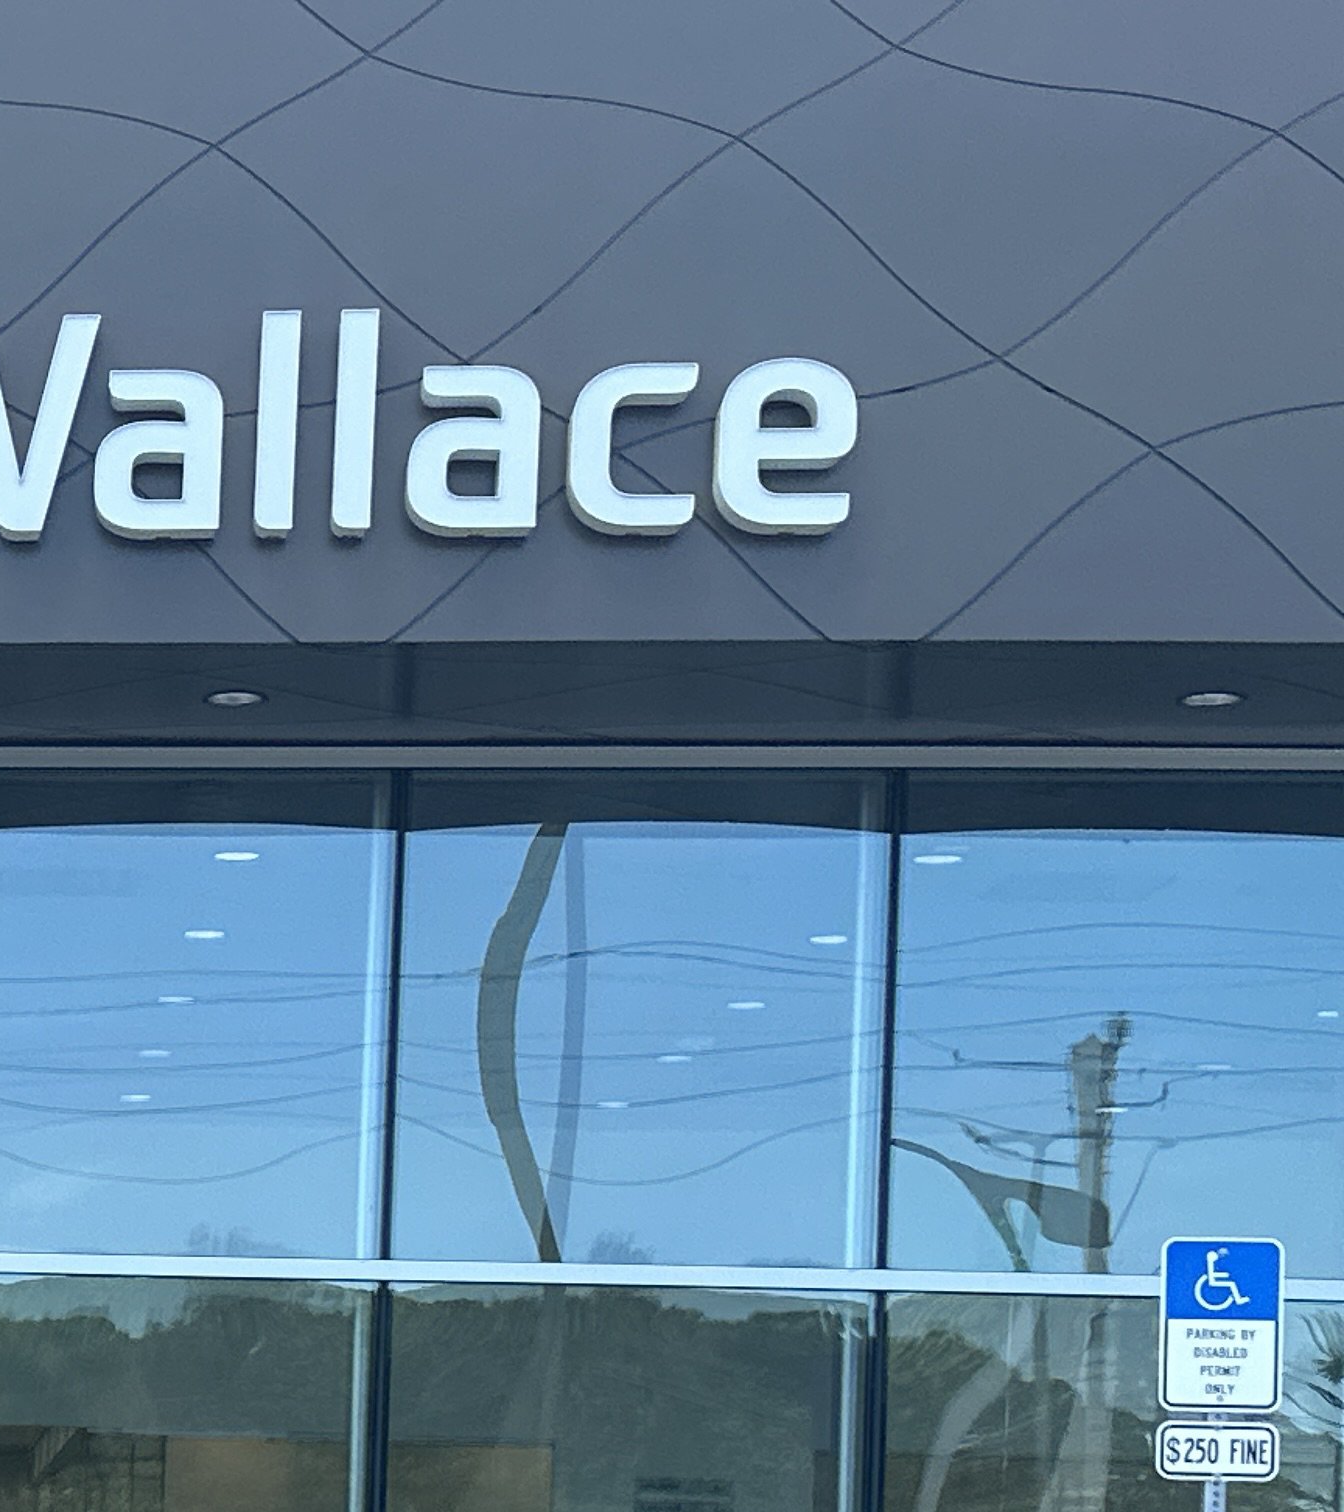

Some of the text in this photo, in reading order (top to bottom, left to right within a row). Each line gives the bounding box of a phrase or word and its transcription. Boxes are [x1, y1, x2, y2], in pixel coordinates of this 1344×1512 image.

[1186, 1328, 1256, 1341] PARKING BY
[1193, 1346, 1248, 1360] DISABLED
[1200, 1364, 1241, 1377] PERMIT
[1205, 1383, 1235, 1396] ONLY
[1166, 1436, 1269, 1466] $250 FINE
